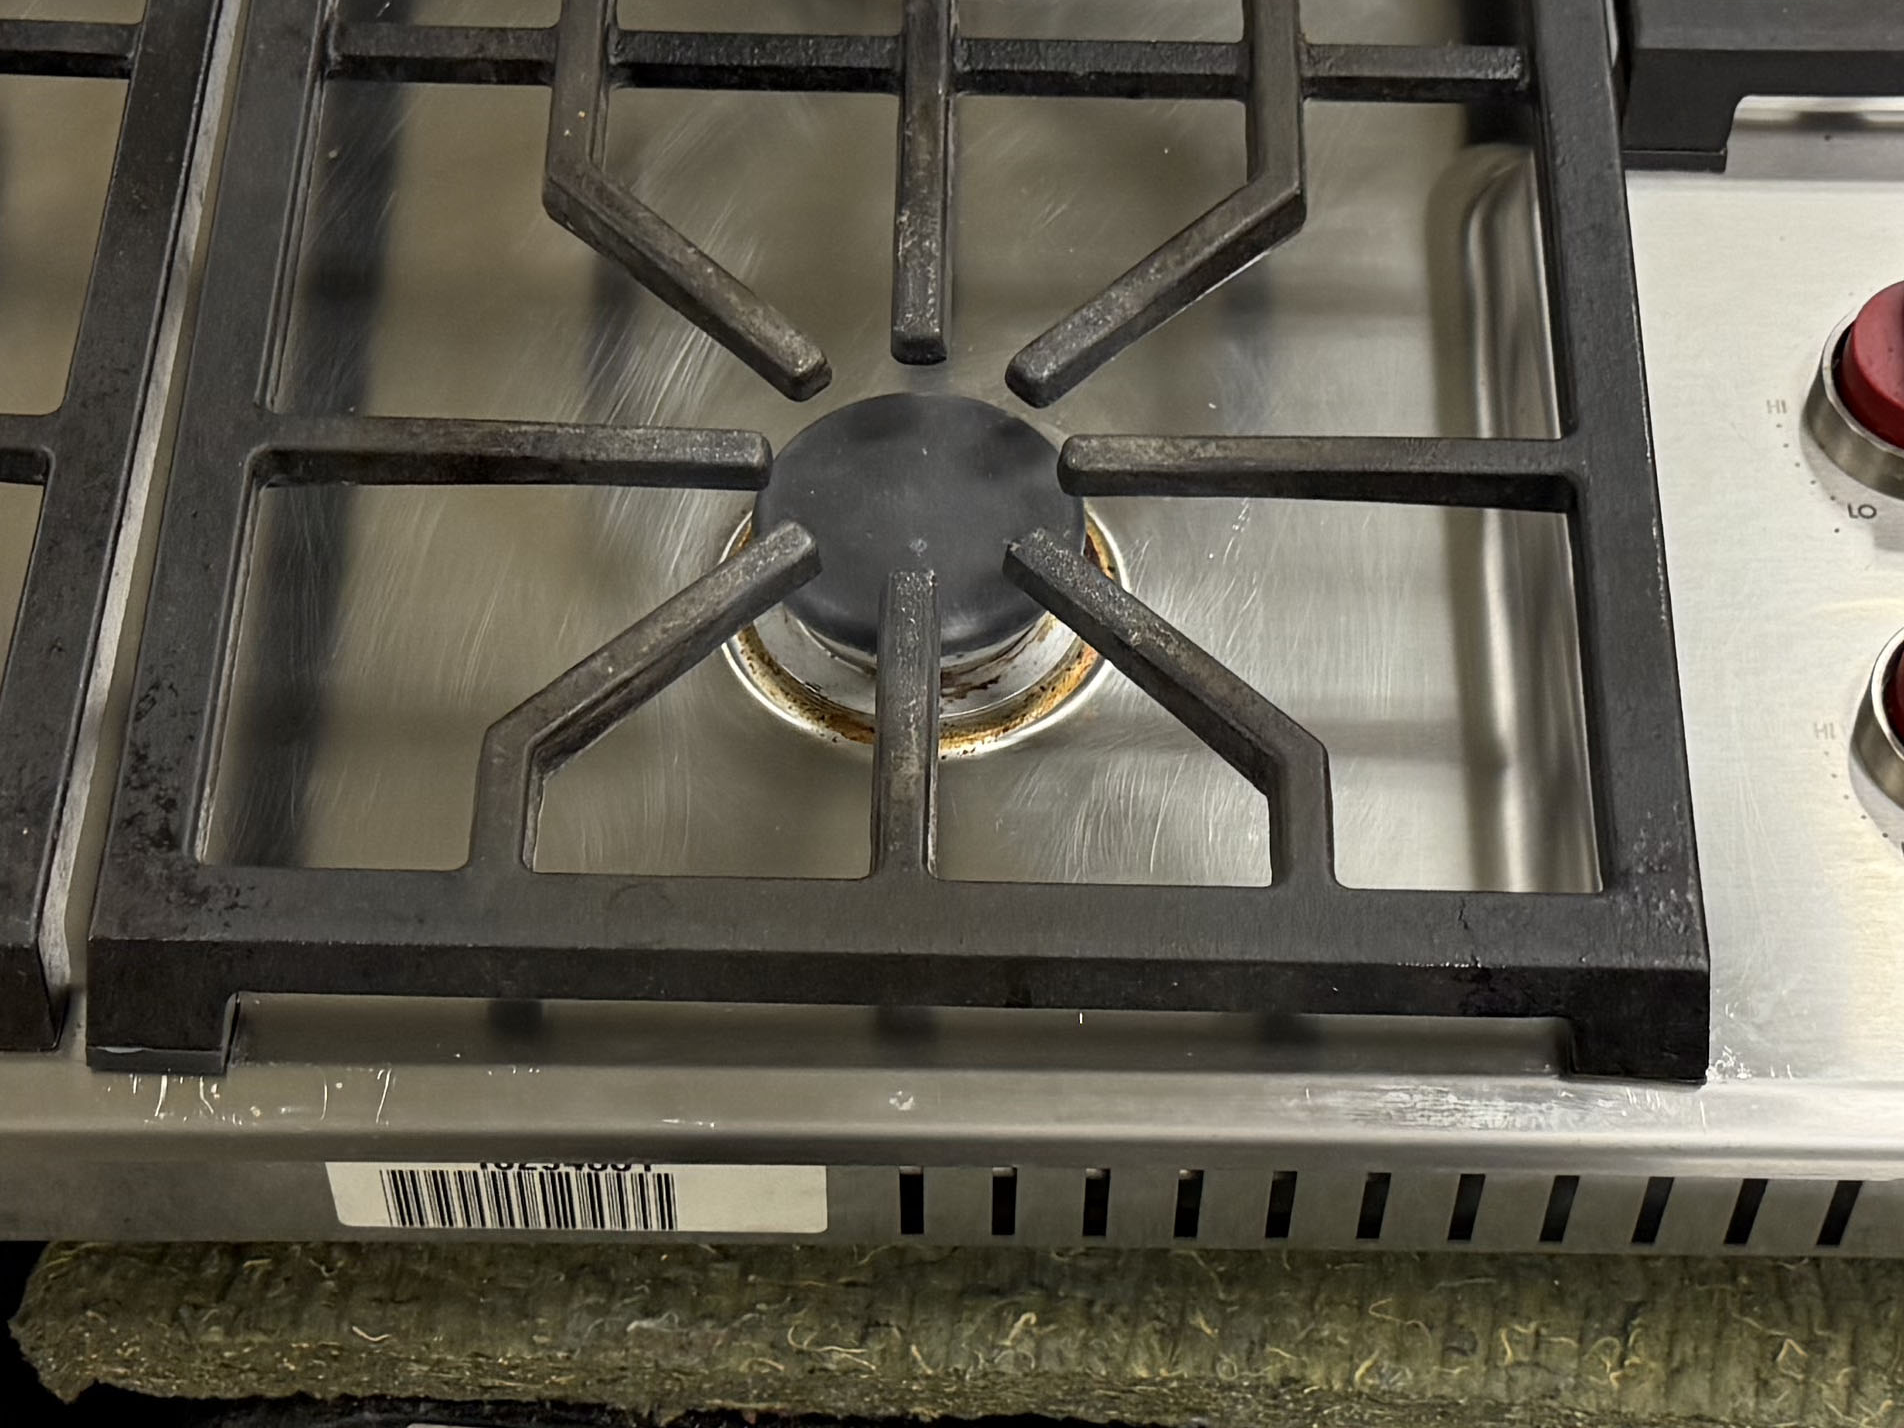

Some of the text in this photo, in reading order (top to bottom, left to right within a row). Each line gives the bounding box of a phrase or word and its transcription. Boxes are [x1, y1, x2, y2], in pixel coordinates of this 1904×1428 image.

[1766, 399, 1788, 414] HI
[1847, 503, 1878, 519] LO
[1813, 723, 1836, 740] HI
